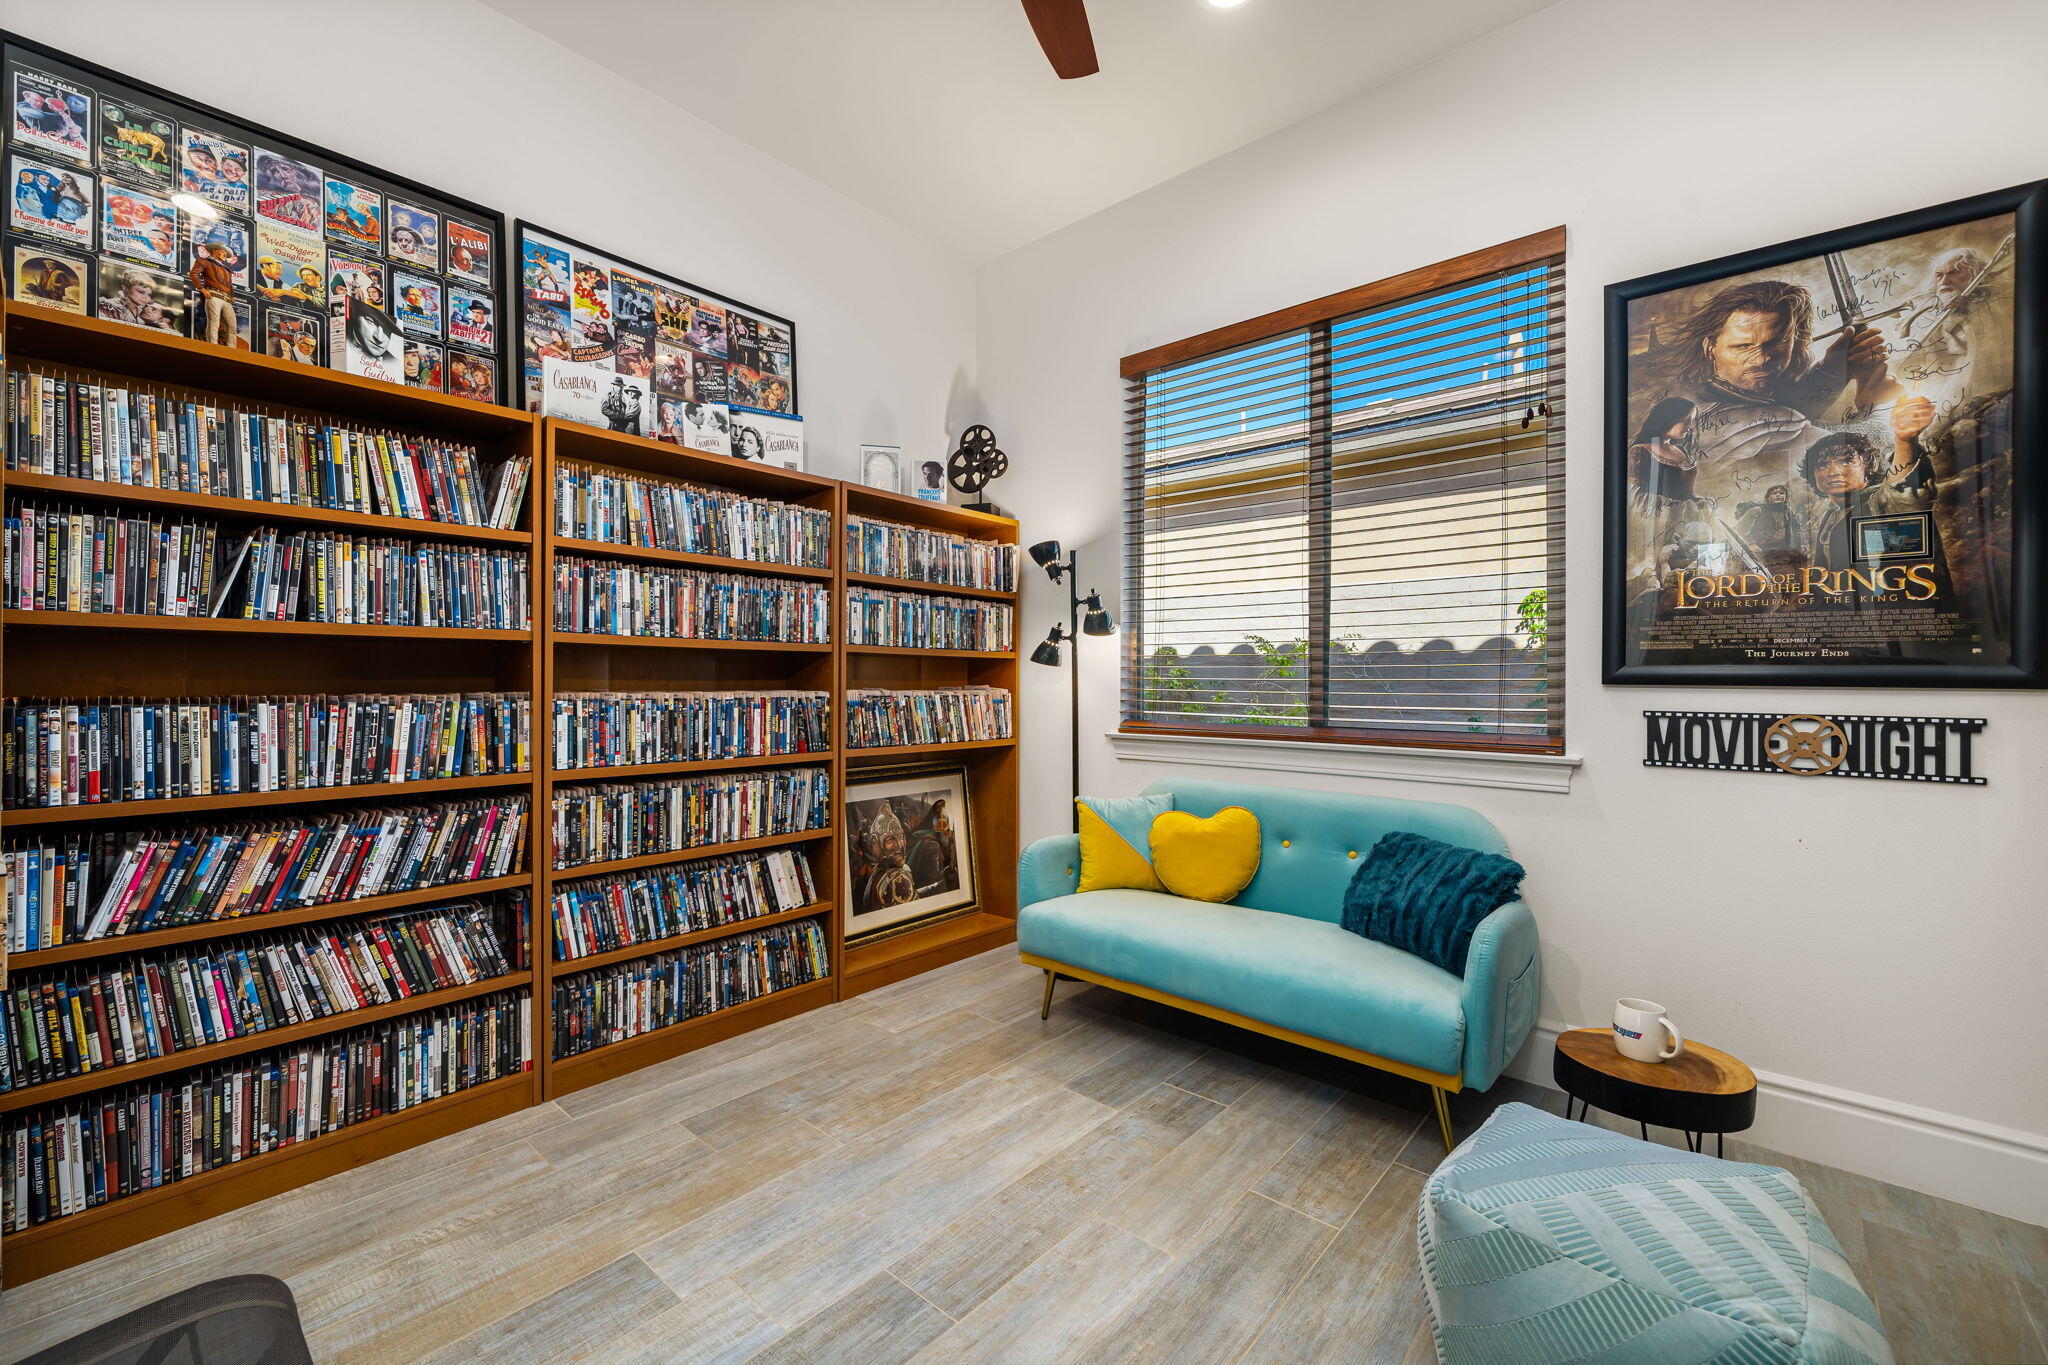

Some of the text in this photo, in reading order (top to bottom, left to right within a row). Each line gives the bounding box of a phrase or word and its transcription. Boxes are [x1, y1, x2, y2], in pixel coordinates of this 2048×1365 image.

[16, 121, 37, 134] Poil
[47, 131, 88, 152] Carotte
[104, 136, 148, 156] CHIEN
[200, 182, 246, 196] Le train
[224, 194, 245, 202] 8h47
[47, 219, 55, 227] de
[56, 222, 74, 233] nulle
[75, 227, 89, 237] part
[450, 236, 487, 250] L'ALIBI
[273, 248, 312, 263] Daughter
[612, 275, 638, 285] LAUREL
[535, 288, 564, 302] TABU
[631, 284, 654, 296] HARDY
[574, 280, 611, 319] ESKIMO
[527, 314, 546, 326] GOOD
[660, 312, 688, 332] SHE
[480, 331, 493, 344] 21
[624, 332, 646, 343] GARBO
[573, 345, 604, 355] CAPTAINS
[574, 350, 614, 361] COURAGEOUS
[553, 369, 597, 392] CASABLANCA
[57, 427, 63, 435] DE
[91, 406, 101, 455] 3:10 TO YUMA
[765, 435, 799, 452] CASABLANCA
[1772, 574, 1794, 584] OF
[1798, 563, 1935, 601] RINGS
[1673, 570, 1766, 609] LORD
[1767, 583, 1801, 594] THE
[1736, 598, 1788, 607] RETURN
[1798, 597, 1815, 605] OF
[1824, 596, 1850, 604] THE
[1860, 594, 1897, 603] KING
[1745, 648, 1850, 659] THE JOURNEY ENDS
[79, 750, 87, 778] CAPE FEAR
[299, 847, 320, 880] MORITURI
[400, 927, 409, 939] KES
[473, 935, 486, 958] TRUE GRIT
[47, 1009, 63, 1059] WILL PENNY
[117, 1109, 125, 1131] CABARET
[183, 1111, 191, 1155] REVENGERS
[55, 1123, 65, 1162] Deliverance
[17, 1142, 26, 1177] COWBOYS
